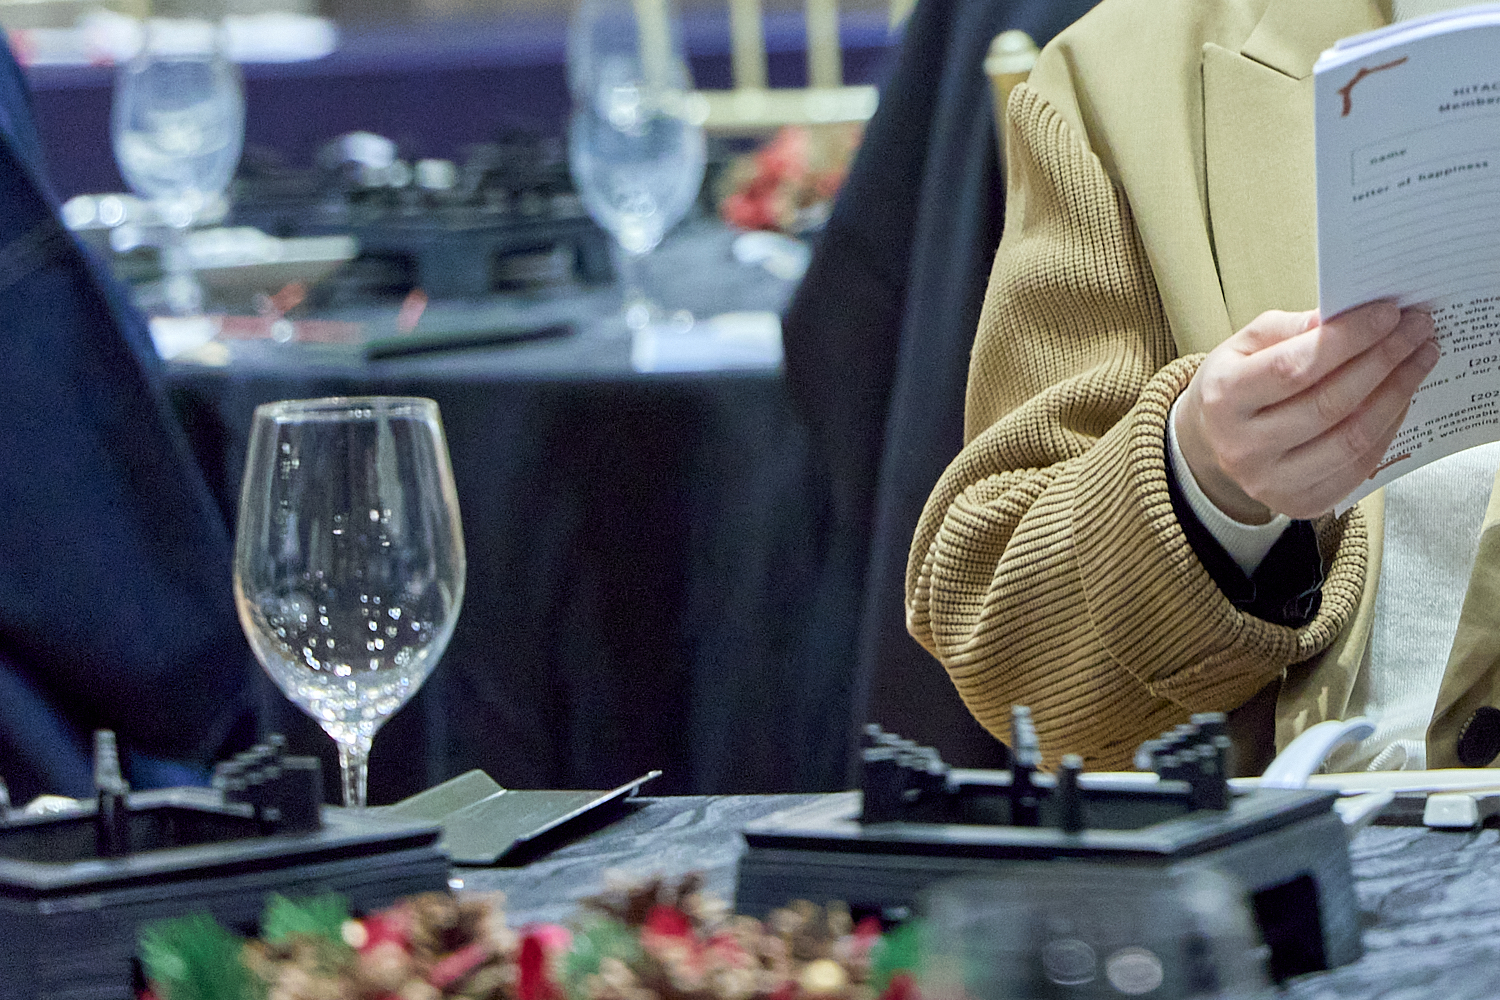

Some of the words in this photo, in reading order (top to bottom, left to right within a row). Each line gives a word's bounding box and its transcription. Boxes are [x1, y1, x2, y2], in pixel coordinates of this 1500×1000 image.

[1438, 96, 1500, 112] Member
[1352, 185, 1388, 202] letter
[1397, 177, 1411, 188] of
[1417, 160, 1488, 181] happiness
[1452, 302, 1463, 310] to
[1464, 304, 1495, 316] when
[1453, 314, 1489, 327] award
[1452, 332, 1483, 345] When
[1453, 339, 1493, 354] helped
[1455, 371, 1466, 380] of
[1472, 366, 1493, 376] our
[1424, 400, 1496, 427] management
[1438, 408, 1500, 431] reasonable
[1427, 436, 1435, 444] a
[1439, 416, 1500, 439] welcoming
